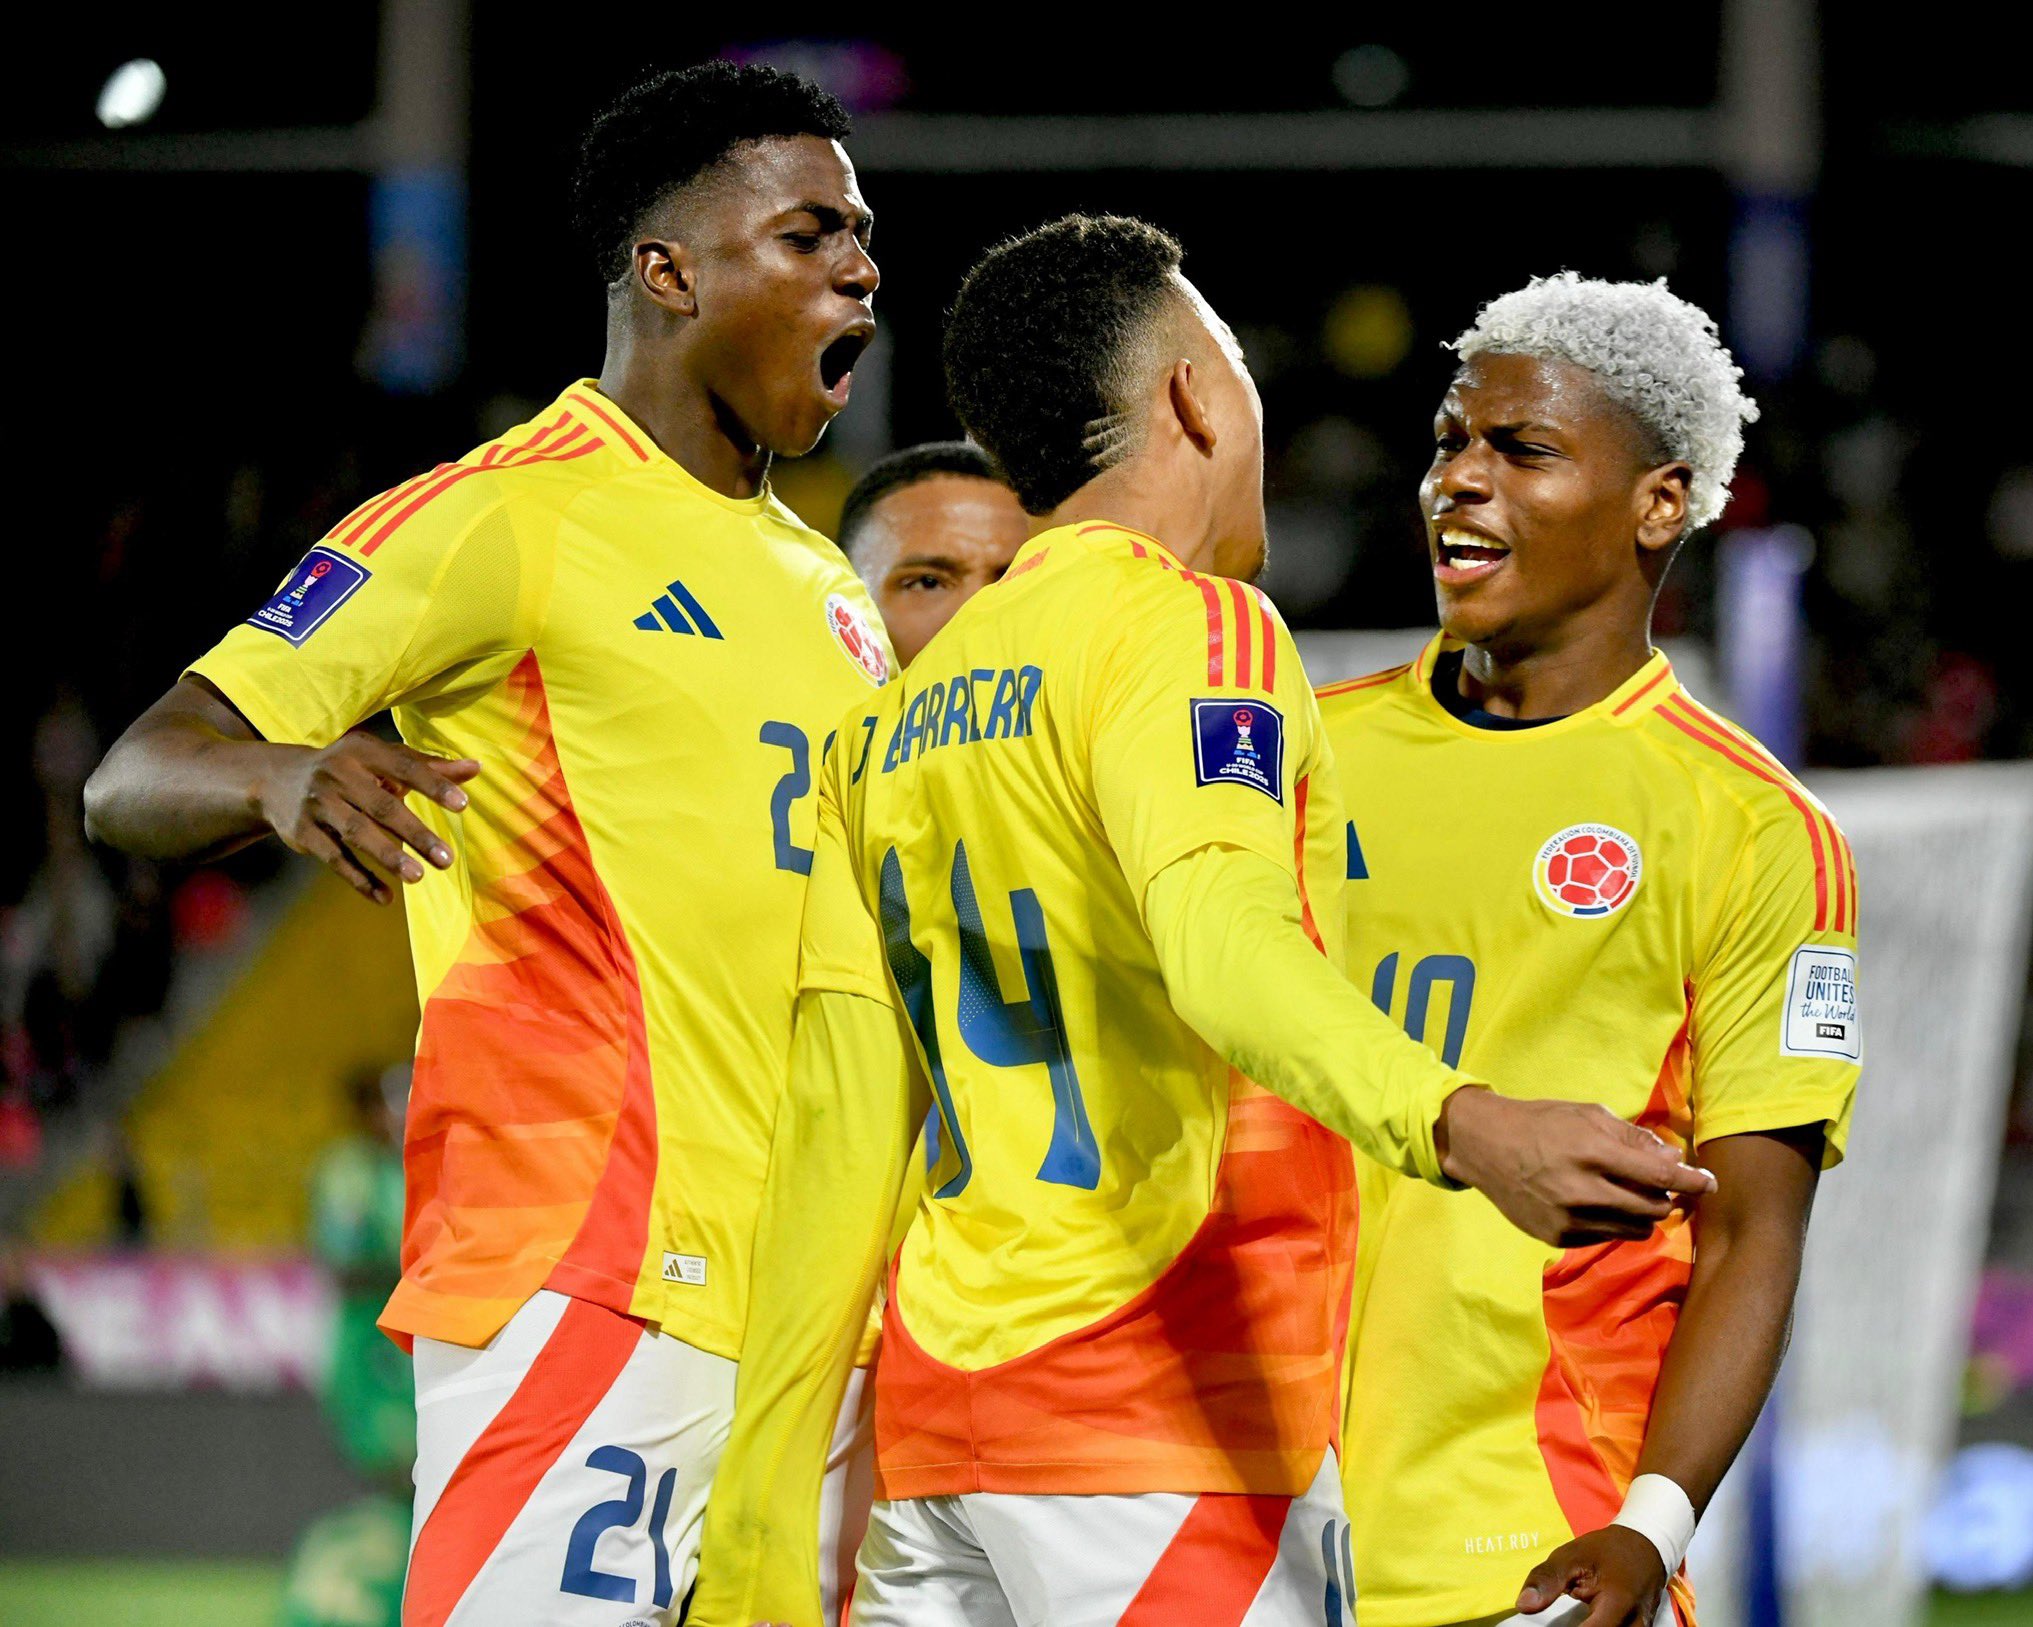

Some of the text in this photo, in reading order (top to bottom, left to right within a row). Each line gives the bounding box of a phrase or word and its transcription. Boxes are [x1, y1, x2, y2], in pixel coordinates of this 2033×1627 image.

[852, 716, 878, 786] J
[1236, 757, 1256, 767] FIFA
[1219, 767, 1249, 776] CHILE
[759, 720, 837, 877] 2
[1805, 981, 1855, 1004] UNITES
[879, 837, 1101, 1199] 14
[1800, 1002, 1821, 1018] the
[1819, 1025, 1843, 1037] FIFA
[560, 1445, 678, 1609] 21
